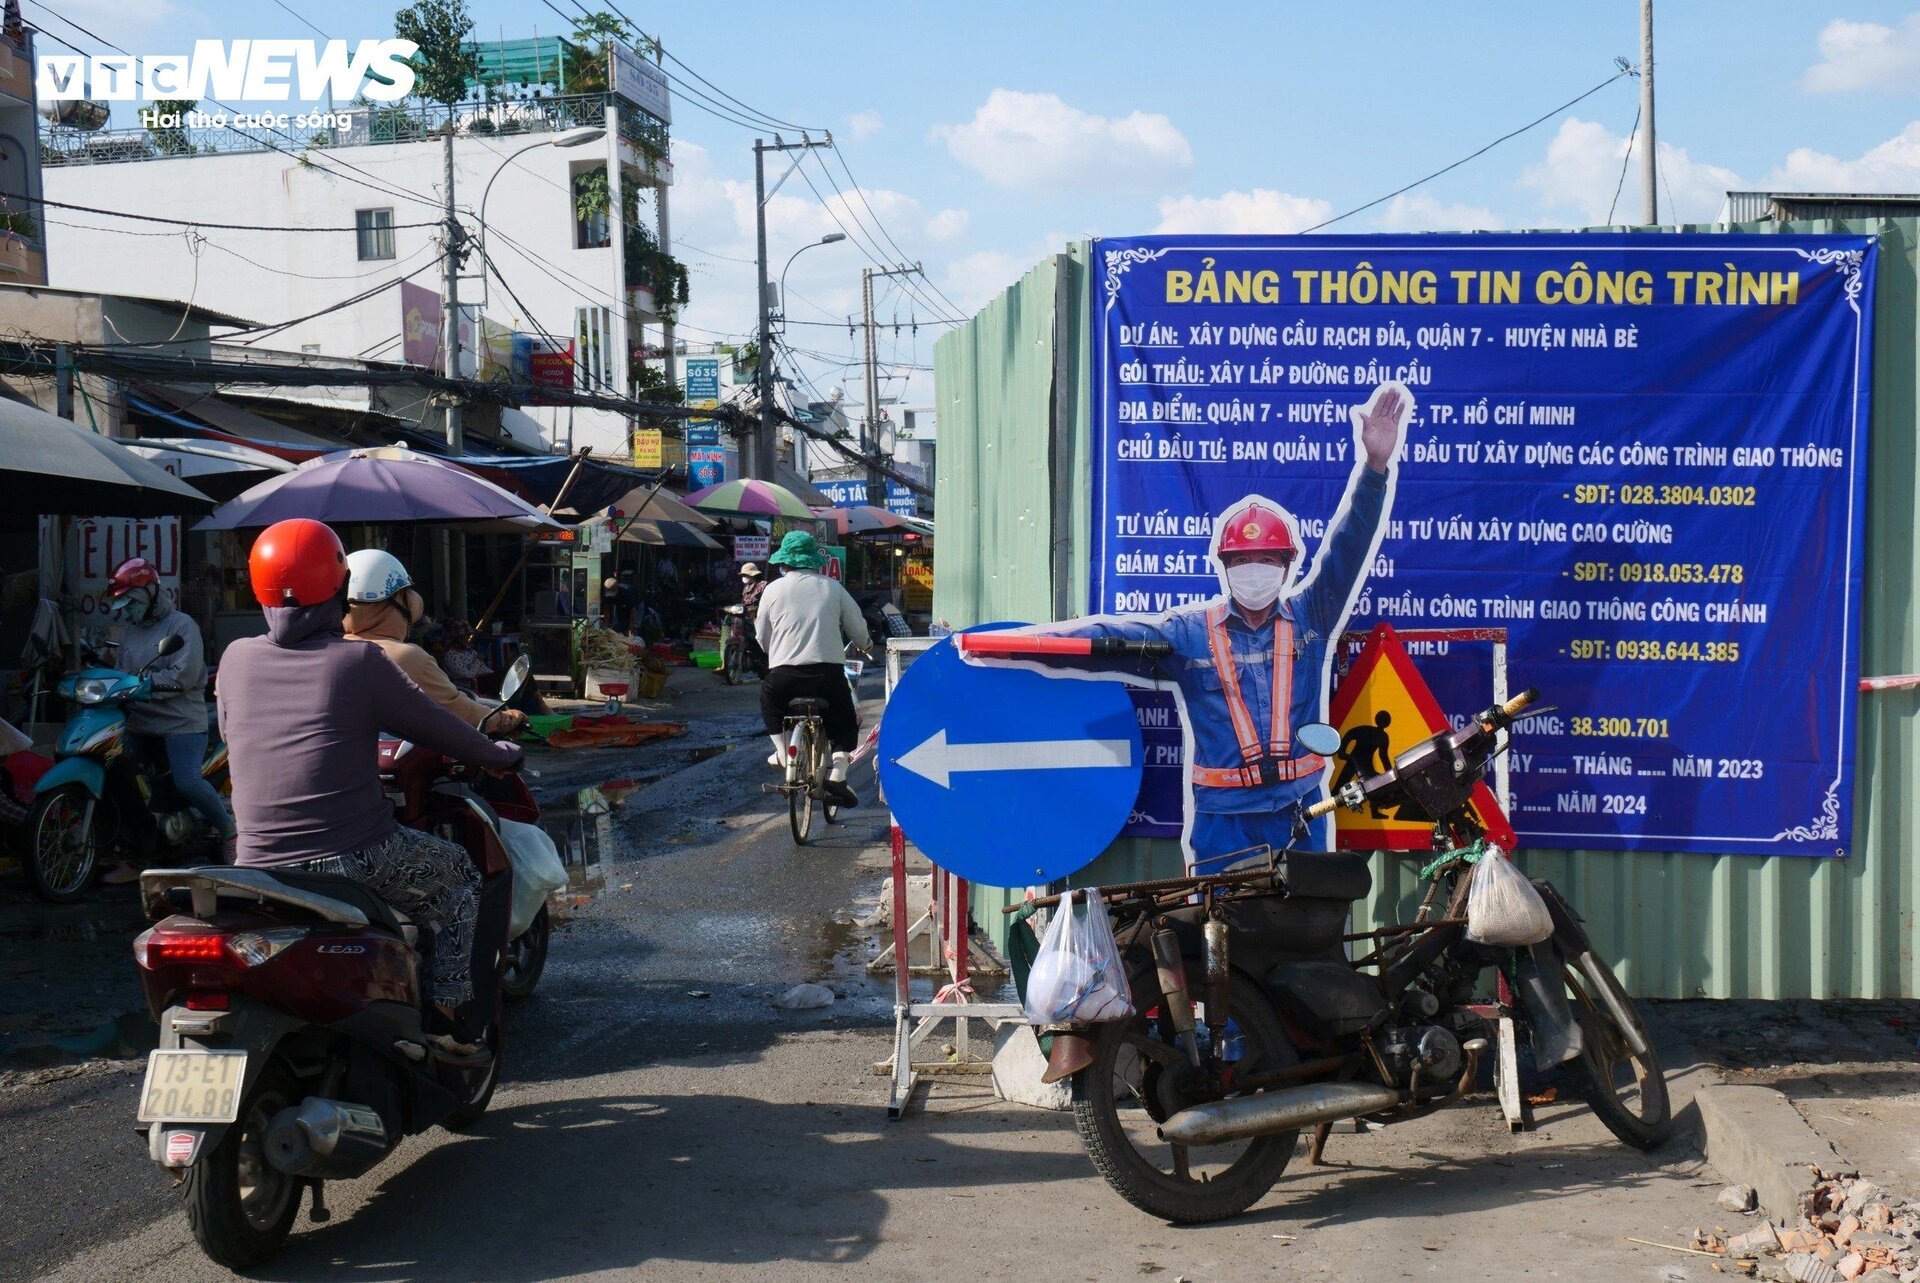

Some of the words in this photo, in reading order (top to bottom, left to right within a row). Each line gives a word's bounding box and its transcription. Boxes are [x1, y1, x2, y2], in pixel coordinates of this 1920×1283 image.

[1166, 257, 1280, 304] BẢNG
[1293, 261, 1437, 305] THÔNG
[1451, 269, 1520, 304] TIN
[1535, 261, 1654, 306] CÔNG
[1667, 261, 1799, 305] TRÌNH
[1120, 323, 1144, 347] DỰ
[1149, 321, 1178, 345] ÁN:
[1189, 321, 1223, 345] XÂY
[1229, 323, 1277, 349] DỰNG
[1282, 319, 1317, 346] CẦU
[1323, 327, 1370, 350] RẠCH
[1376, 321, 1411, 350] ĐỈA,
[1417, 323, 1464, 350] QUẬN
[1471, 328, 1481, 347] 7
[1505, 323, 1566, 351] HUYỆN
[1571, 323, 1608, 348] NHÀ
[1614, 323, 1638, 348] BÈ
[688, 366, 702, 377] SỐ
[703, 368, 717, 377] 35
[1119, 358, 1147, 382] GÓI
[1153, 356, 1204, 383] THẦU:
[1210, 360, 1244, 384] XÂY
[1250, 357, 1284, 384] LẮP
[1289, 360, 1349, 385] ĐƯỜNG
[1354, 358, 1390, 385] ĐẦU
[1396, 358, 1432, 385] CẦU
[1119, 401, 1148, 424] ĐỊA
[1152, 392, 1202, 421] ĐIỂM:
[1207, 398, 1255, 426] QUẬN
[1260, 403, 1271, 422] 7
[1288, 399, 1347, 426] HUYỆN
[1430, 405, 1457, 424] TP.
[1464, 397, 1488, 424] HỒ
[1494, 401, 1525, 425] CHÍ
[1529, 406, 1575, 425] MINH
[1117, 432, 1153, 458] CHỦ
[1158, 432, 1194, 459] ĐẦU
[1199, 438, 1227, 460] TƯ:
[1232, 442, 1267, 460] BAN
[1273, 435, 1320, 463] QUẢN
[1326, 438, 1348, 462] LÝ
[1414, 435, 1450, 463] ĐẦU
[1455, 441, 1480, 463] TƯ
[1484, 439, 1519, 464] XÂY
[1525, 441, 1573, 468] DỰNG
[1578, 440, 1614, 465] CÁC
[1619, 441, 1668, 466] CÔNG
[1673, 441, 1727, 466] TRÌNH
[1732, 447, 1775, 467] GIAO
[1780, 442, 1843, 468] THÔNG
[889, 496, 915, 506] THUỐC
[1575, 485, 1615, 505] SĐT:
[1620, 486, 1756, 506] 028.3804.0302
[1116, 513, 1140, 535] TƯ
[1144, 509, 1178, 535] VẤN
[1409, 518, 1434, 540] TƯ
[1437, 514, 1473, 541] VẤN
[1478, 517, 1513, 541] XÂY
[1518, 519, 1567, 545] DỰNG
[1572, 523, 1607, 543] CAO
[1612, 519, 1672, 544] CƯỜNG
[1116, 550, 1159, 574] GIÁM
[1164, 550, 1197, 574] SÁT
[1574, 562, 1613, 581] SĐT:
[1620, 563, 1743, 583] 0918.053.478
[1116, 590, 1149, 611] ĐƠN
[1378, 590, 1424, 616] PHẦN
[1430, 594, 1477, 618] CÔNG
[1482, 595, 1534, 619] TRÌNH
[1540, 600, 1581, 620] GIAO
[1586, 597, 1646, 621] THÔNG
[1651, 597, 1700, 622] CÔNG
[1705, 599, 1767, 623] CHÁNH
[1571, 640, 1610, 659] SĐT:
[1616, 640, 1739, 662] 0938.644.385
[1571, 717, 1669, 738] 38.300.701
[1573, 751, 1632, 775] THÁNG
[1672, 754, 1713, 777] NĂM
[1717, 759, 1763, 779] 2023
[1557, 791, 1597, 813] NĂM
[1602, 795, 1647, 815] 2024
[316, 945, 365, 953] LEAD
